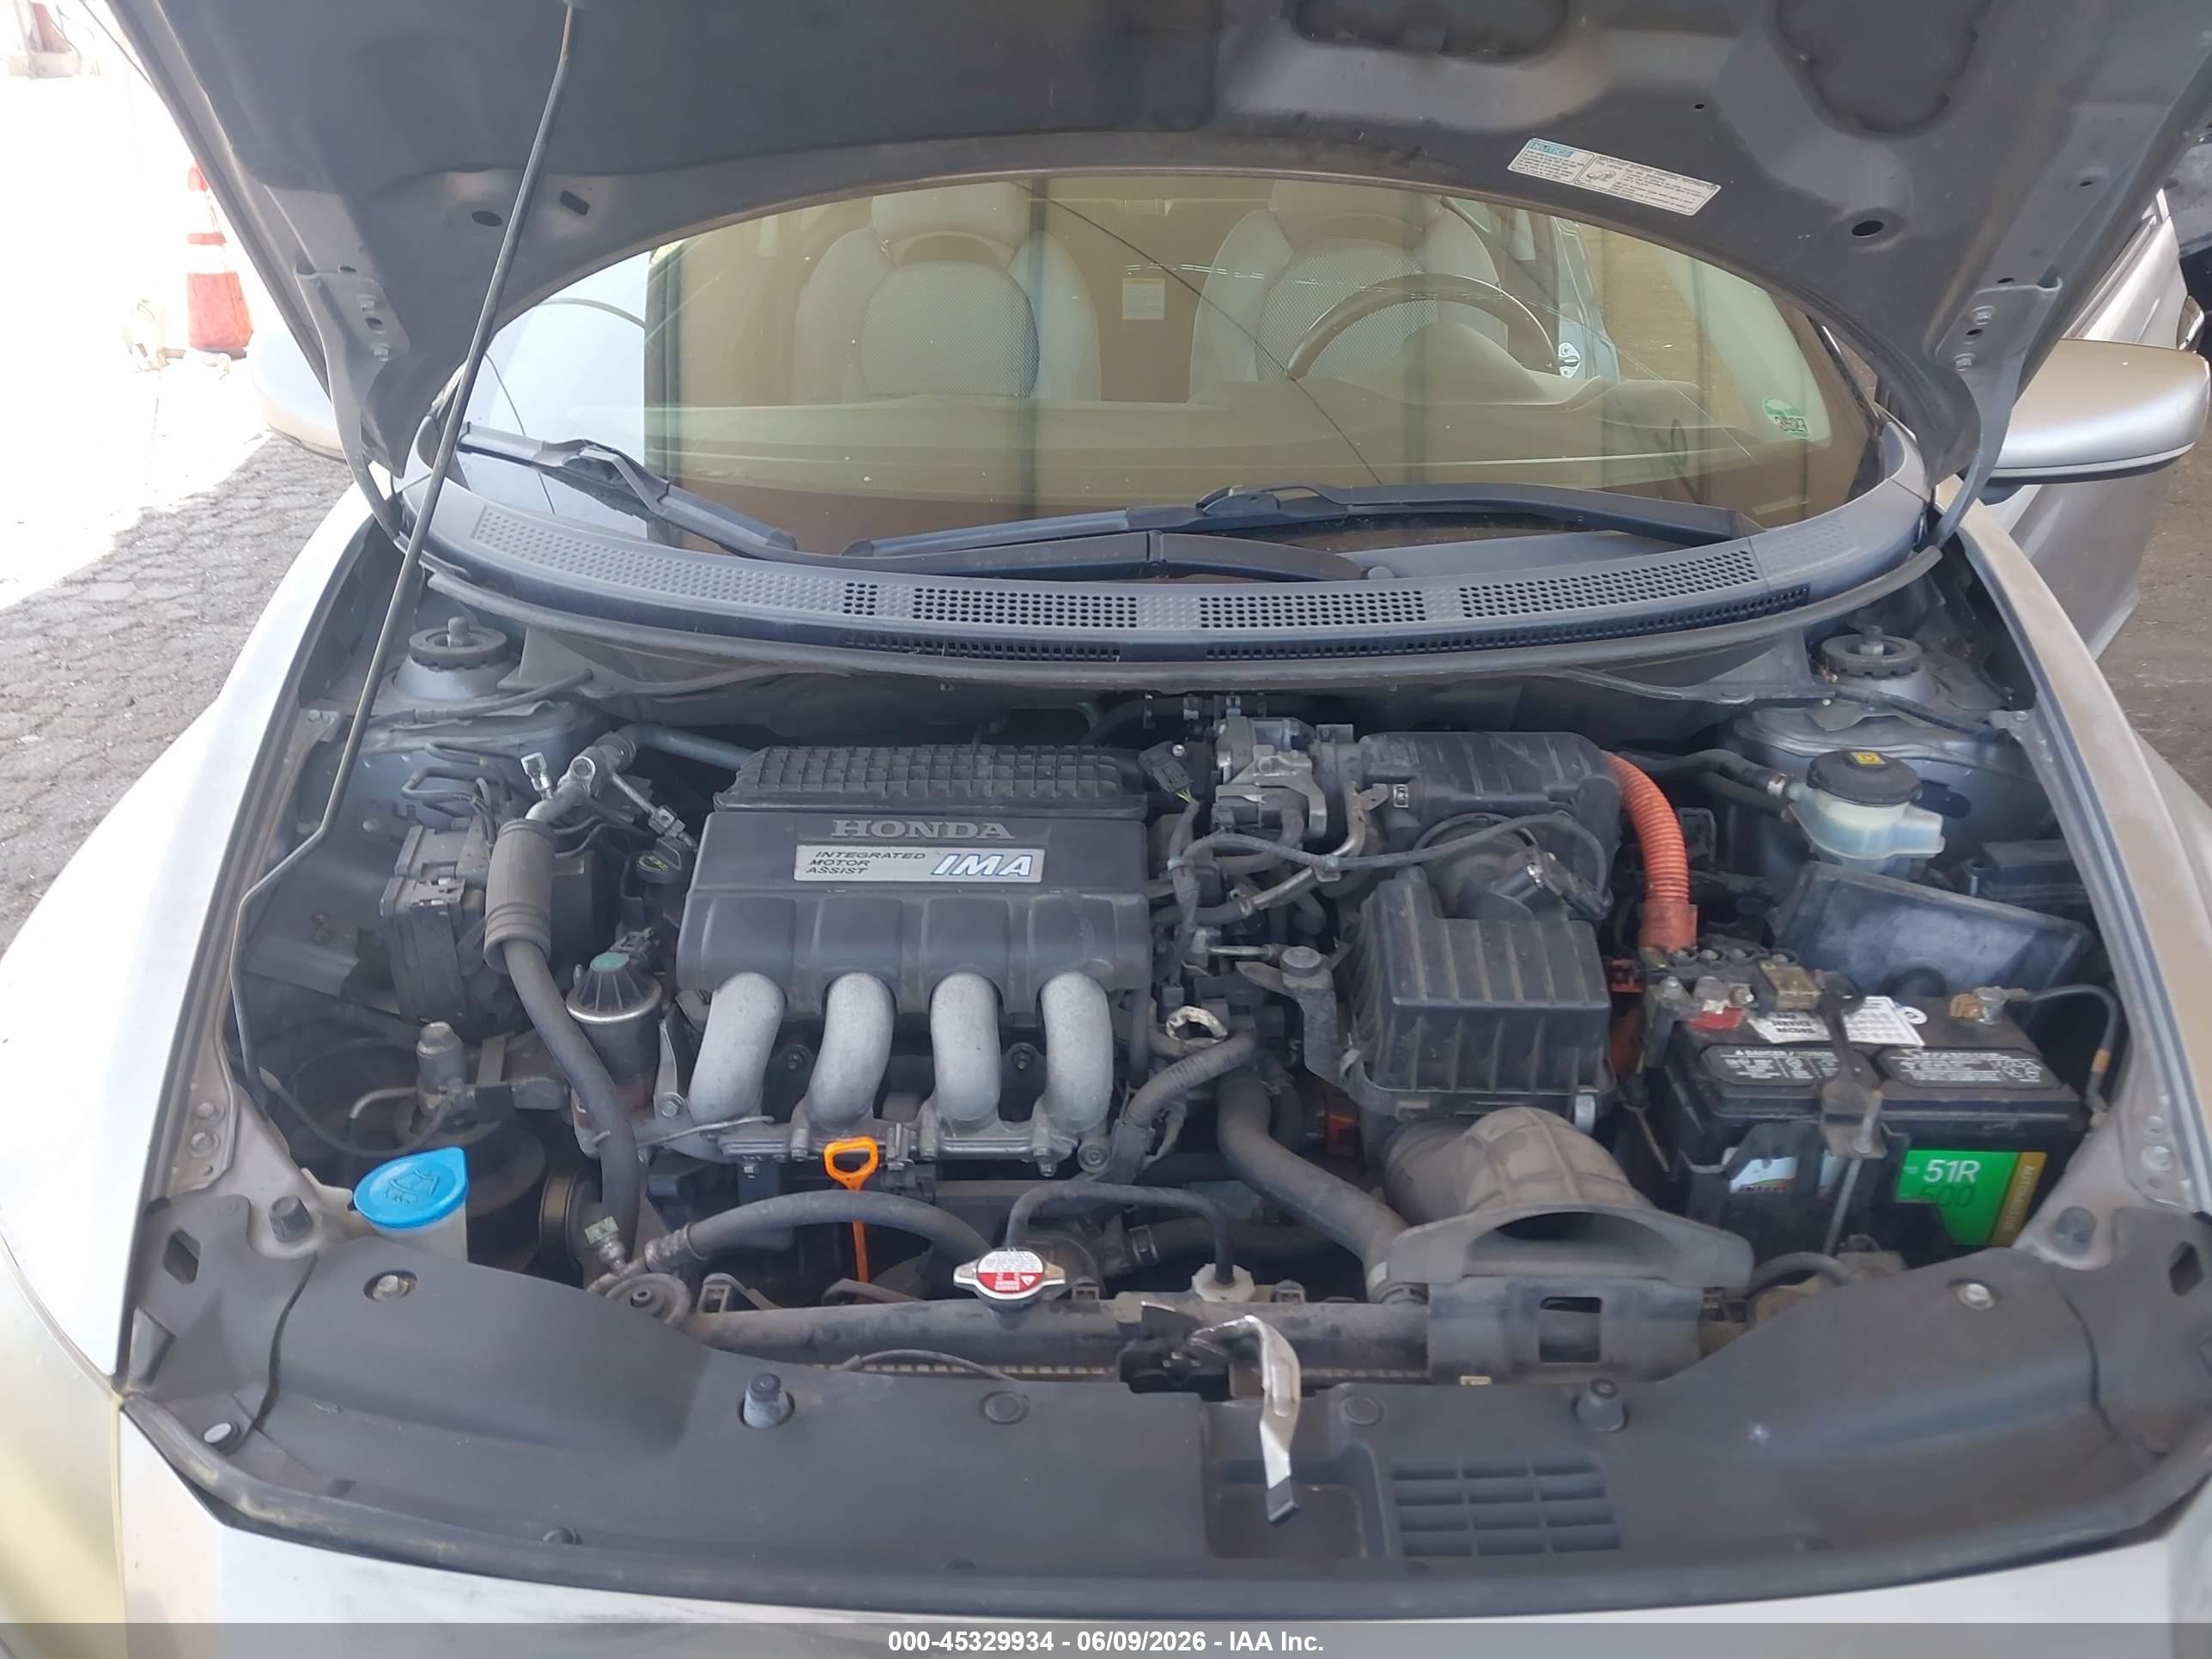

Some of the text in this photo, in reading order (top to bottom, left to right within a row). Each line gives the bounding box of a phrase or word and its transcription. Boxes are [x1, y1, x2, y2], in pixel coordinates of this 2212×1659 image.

[830, 819, 1015, 840] HONDA
[815, 851, 926, 860] INTEGRATED
[930, 853, 1034, 877] IMA
[805, 866, 868, 875] ASSIST
[1923, 1158, 1981, 1183] 51R
